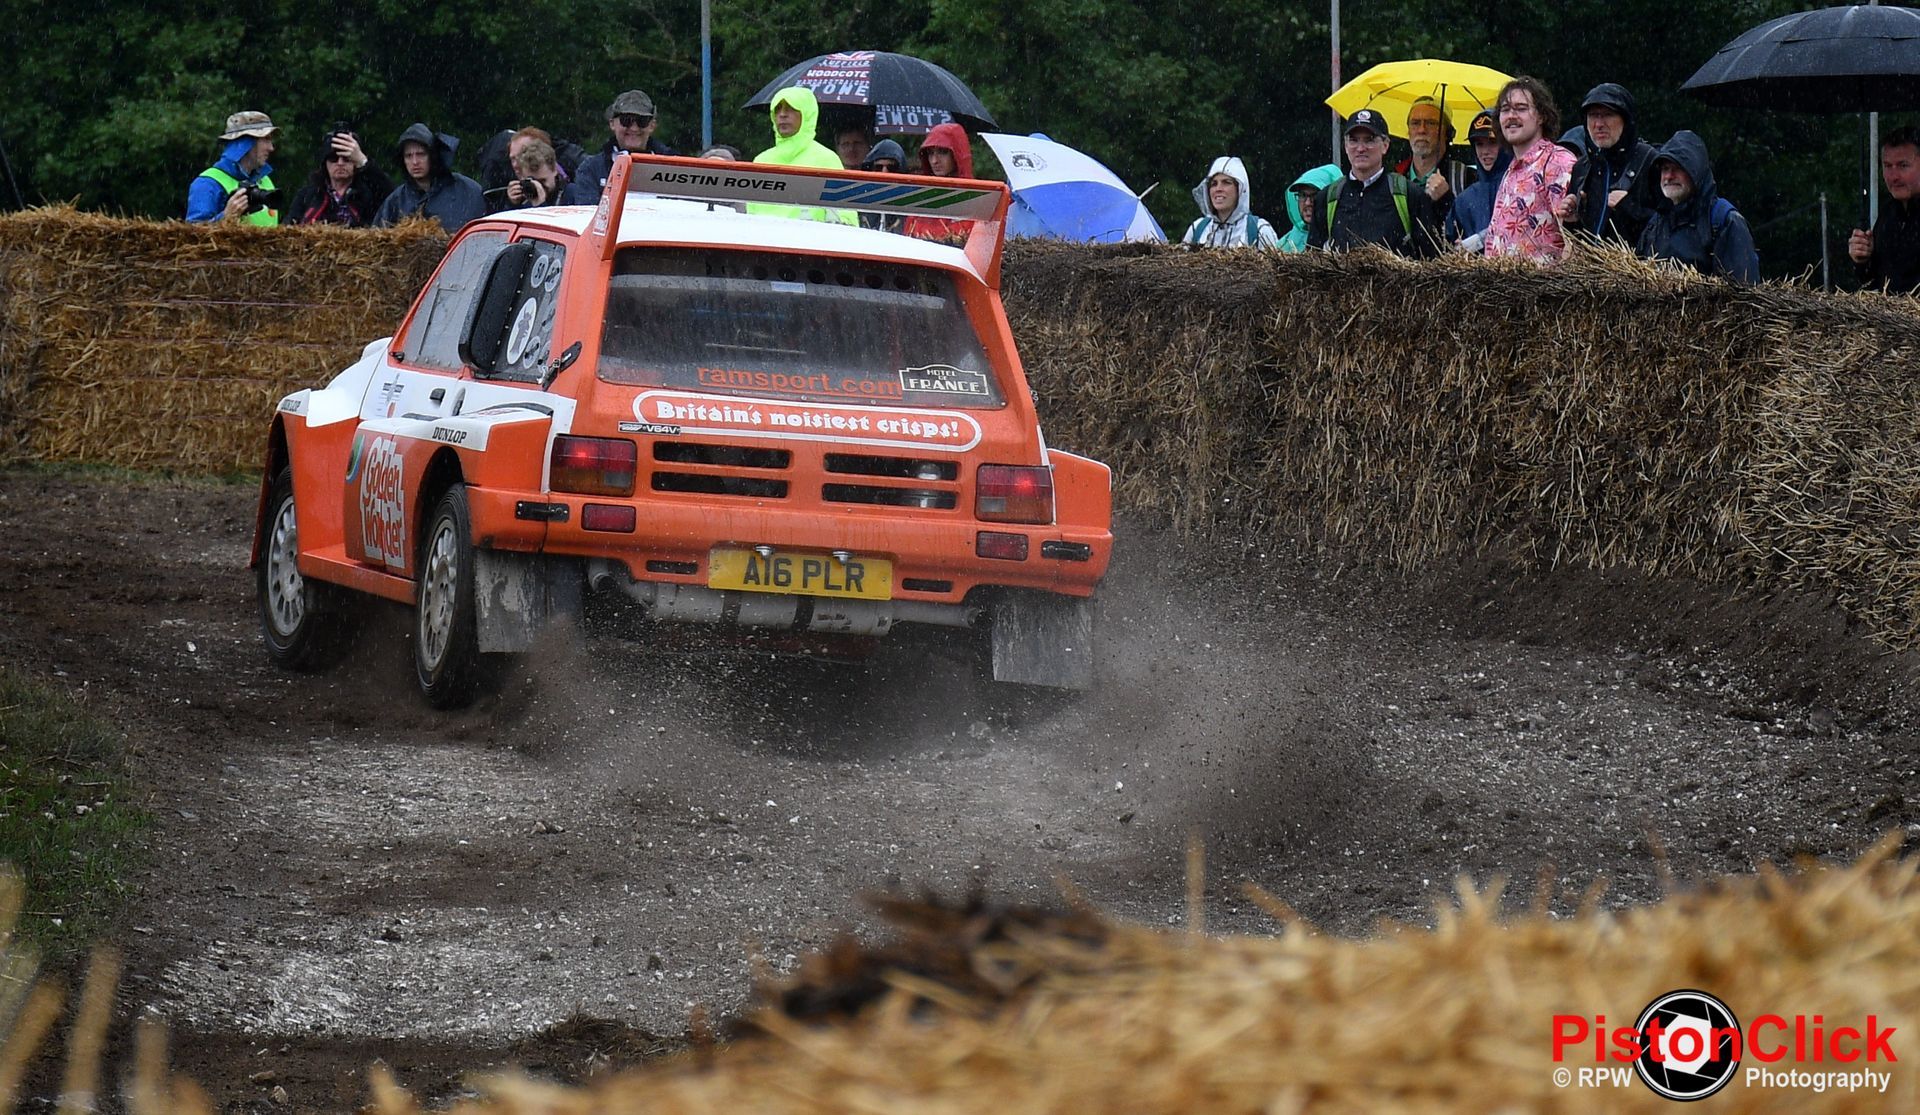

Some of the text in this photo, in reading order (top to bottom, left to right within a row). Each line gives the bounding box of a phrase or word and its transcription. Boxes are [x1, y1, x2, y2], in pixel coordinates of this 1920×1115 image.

[807, 69, 870, 78] WOODCOTE
[651, 172, 787, 191] AUSTIN ROVER
[697, 366, 903, 396] ramsport.com
[926, 369, 957, 377] HOTEL
[909, 378, 981, 393] FRANCE
[646, 424, 677, 434] V64V
[656, 401, 959, 438] Britain's noisiest crisps!
[432, 426, 467, 444] DUNLOP
[365, 446, 402, 512] Golden
[363, 505, 403, 559] Wonder
[744, 557, 864, 592] A16 PLR
